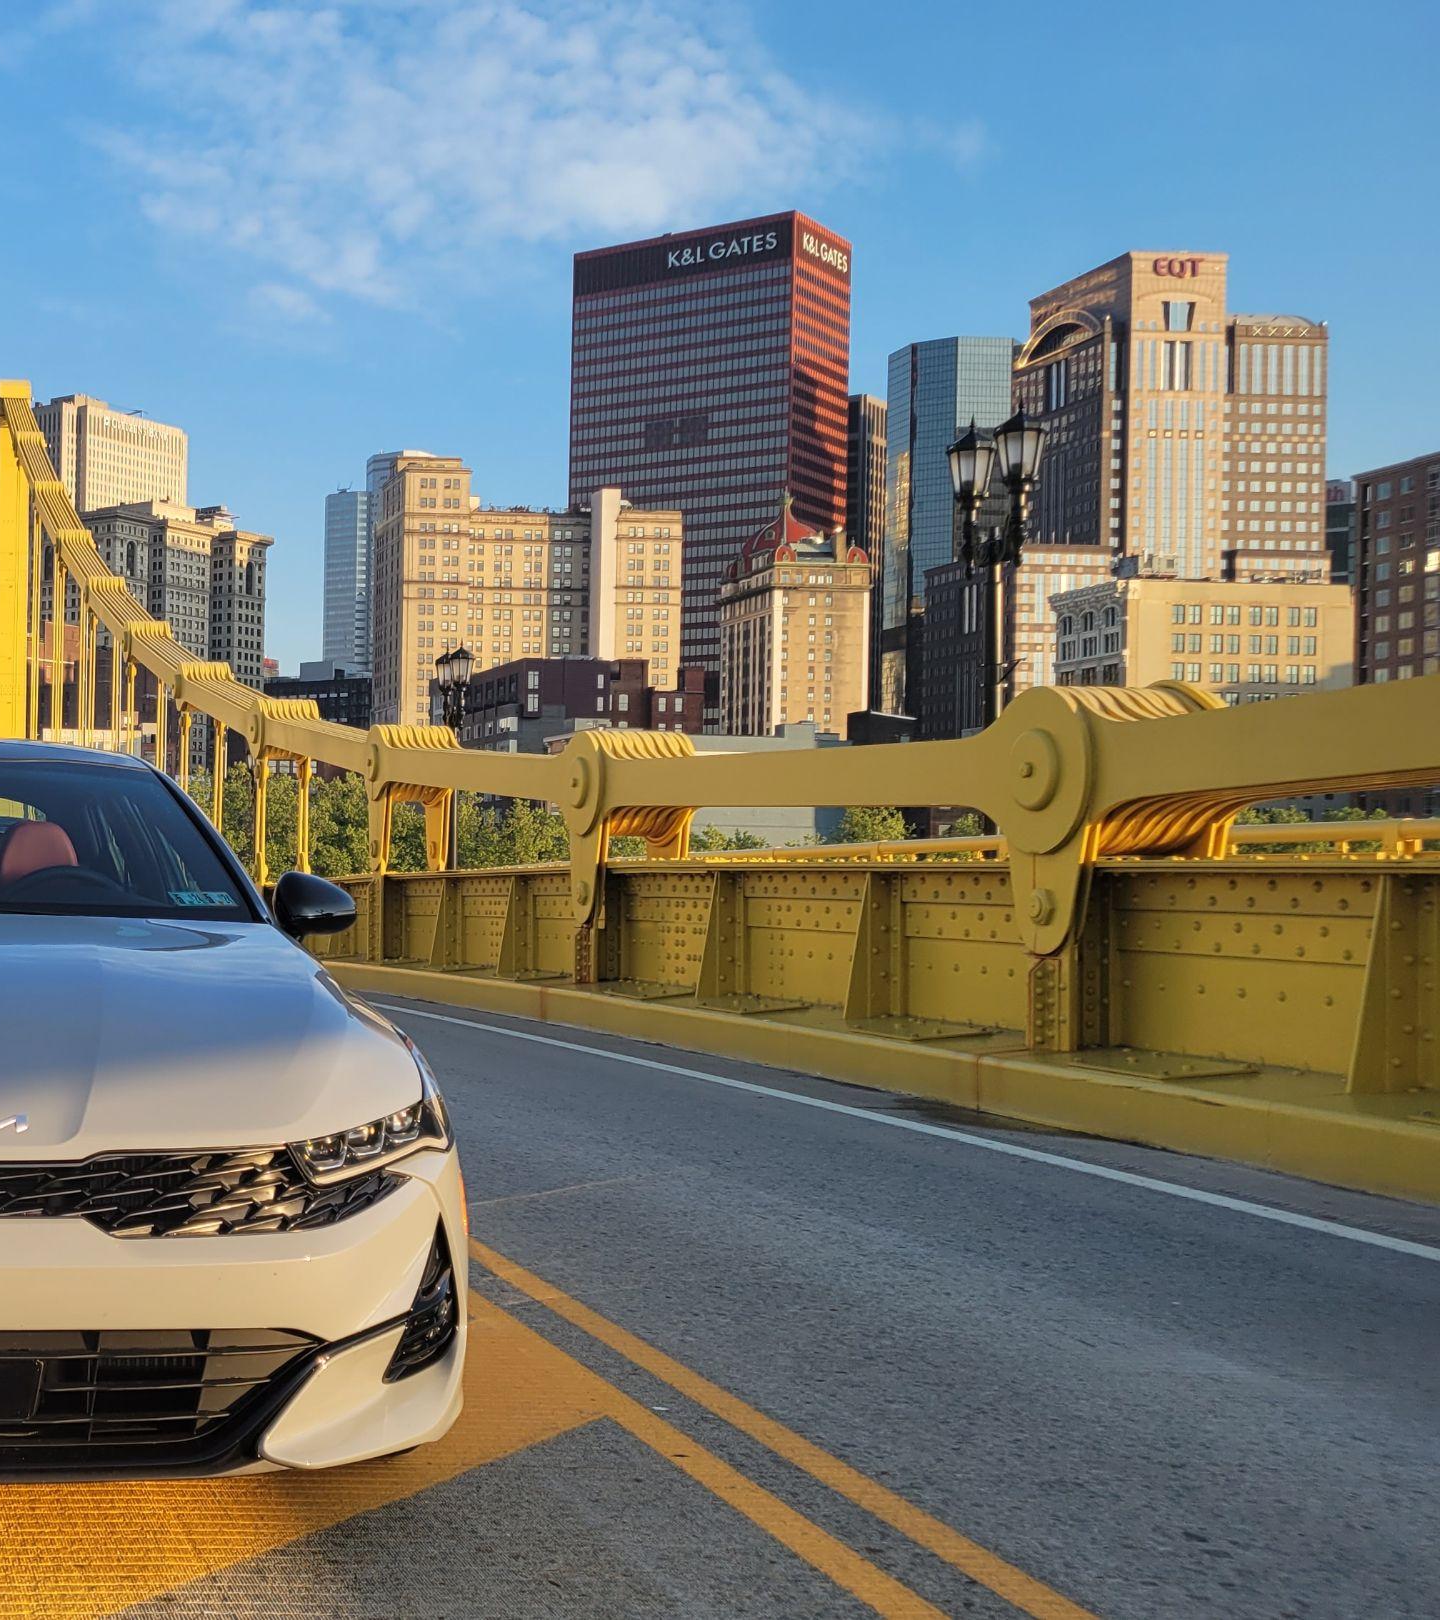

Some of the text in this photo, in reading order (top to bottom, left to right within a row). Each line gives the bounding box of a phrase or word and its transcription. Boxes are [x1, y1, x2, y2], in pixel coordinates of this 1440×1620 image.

[667, 231, 778, 269] K&L GATES
[802, 232, 848, 273] K&L GATES
[1152, 256, 1205, 278] EQT
